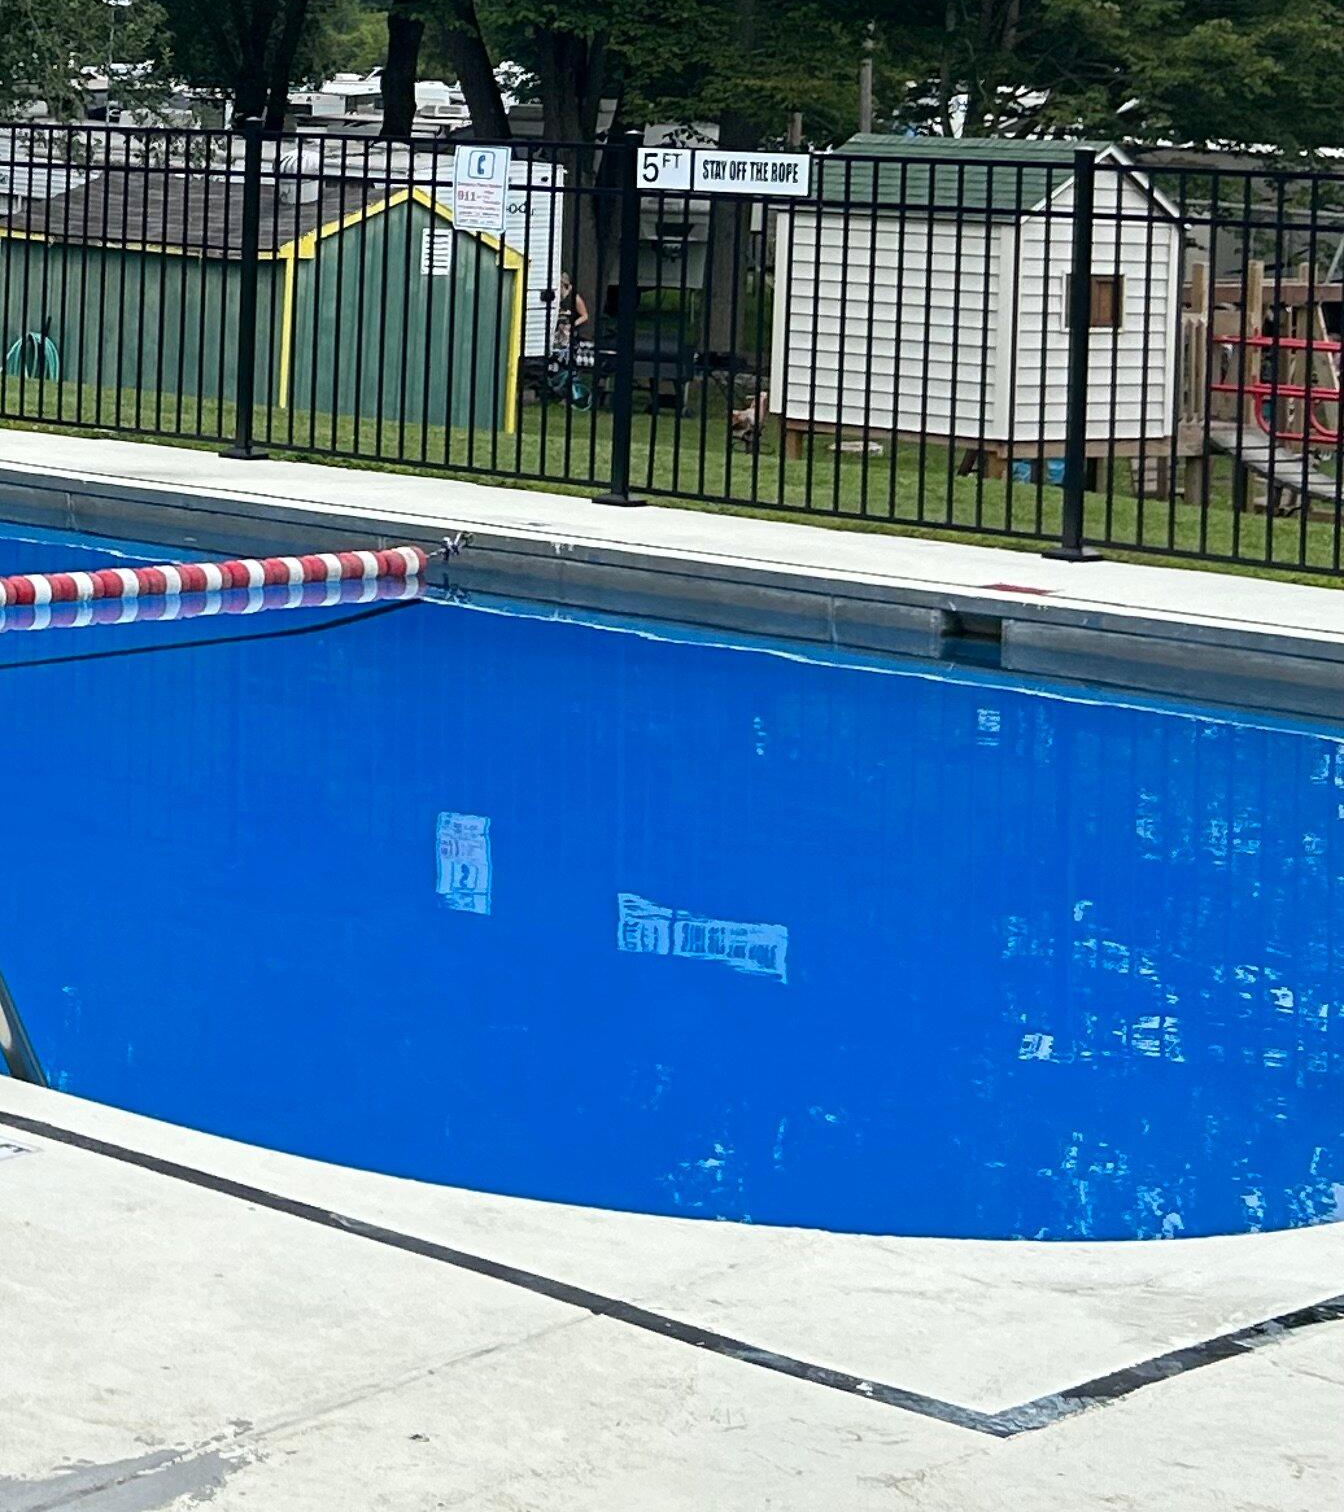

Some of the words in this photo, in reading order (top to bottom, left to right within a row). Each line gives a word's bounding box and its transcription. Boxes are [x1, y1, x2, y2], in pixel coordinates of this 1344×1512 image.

[642, 152, 659, 182] 5
[662, 153, 683, 169] FT
[702, 159, 727, 181] STAY
[729, 160, 748, 181] OFF
[750, 161, 769, 182] THE
[771, 162, 799, 184] ROPE
[458, 190, 477, 201] 911
